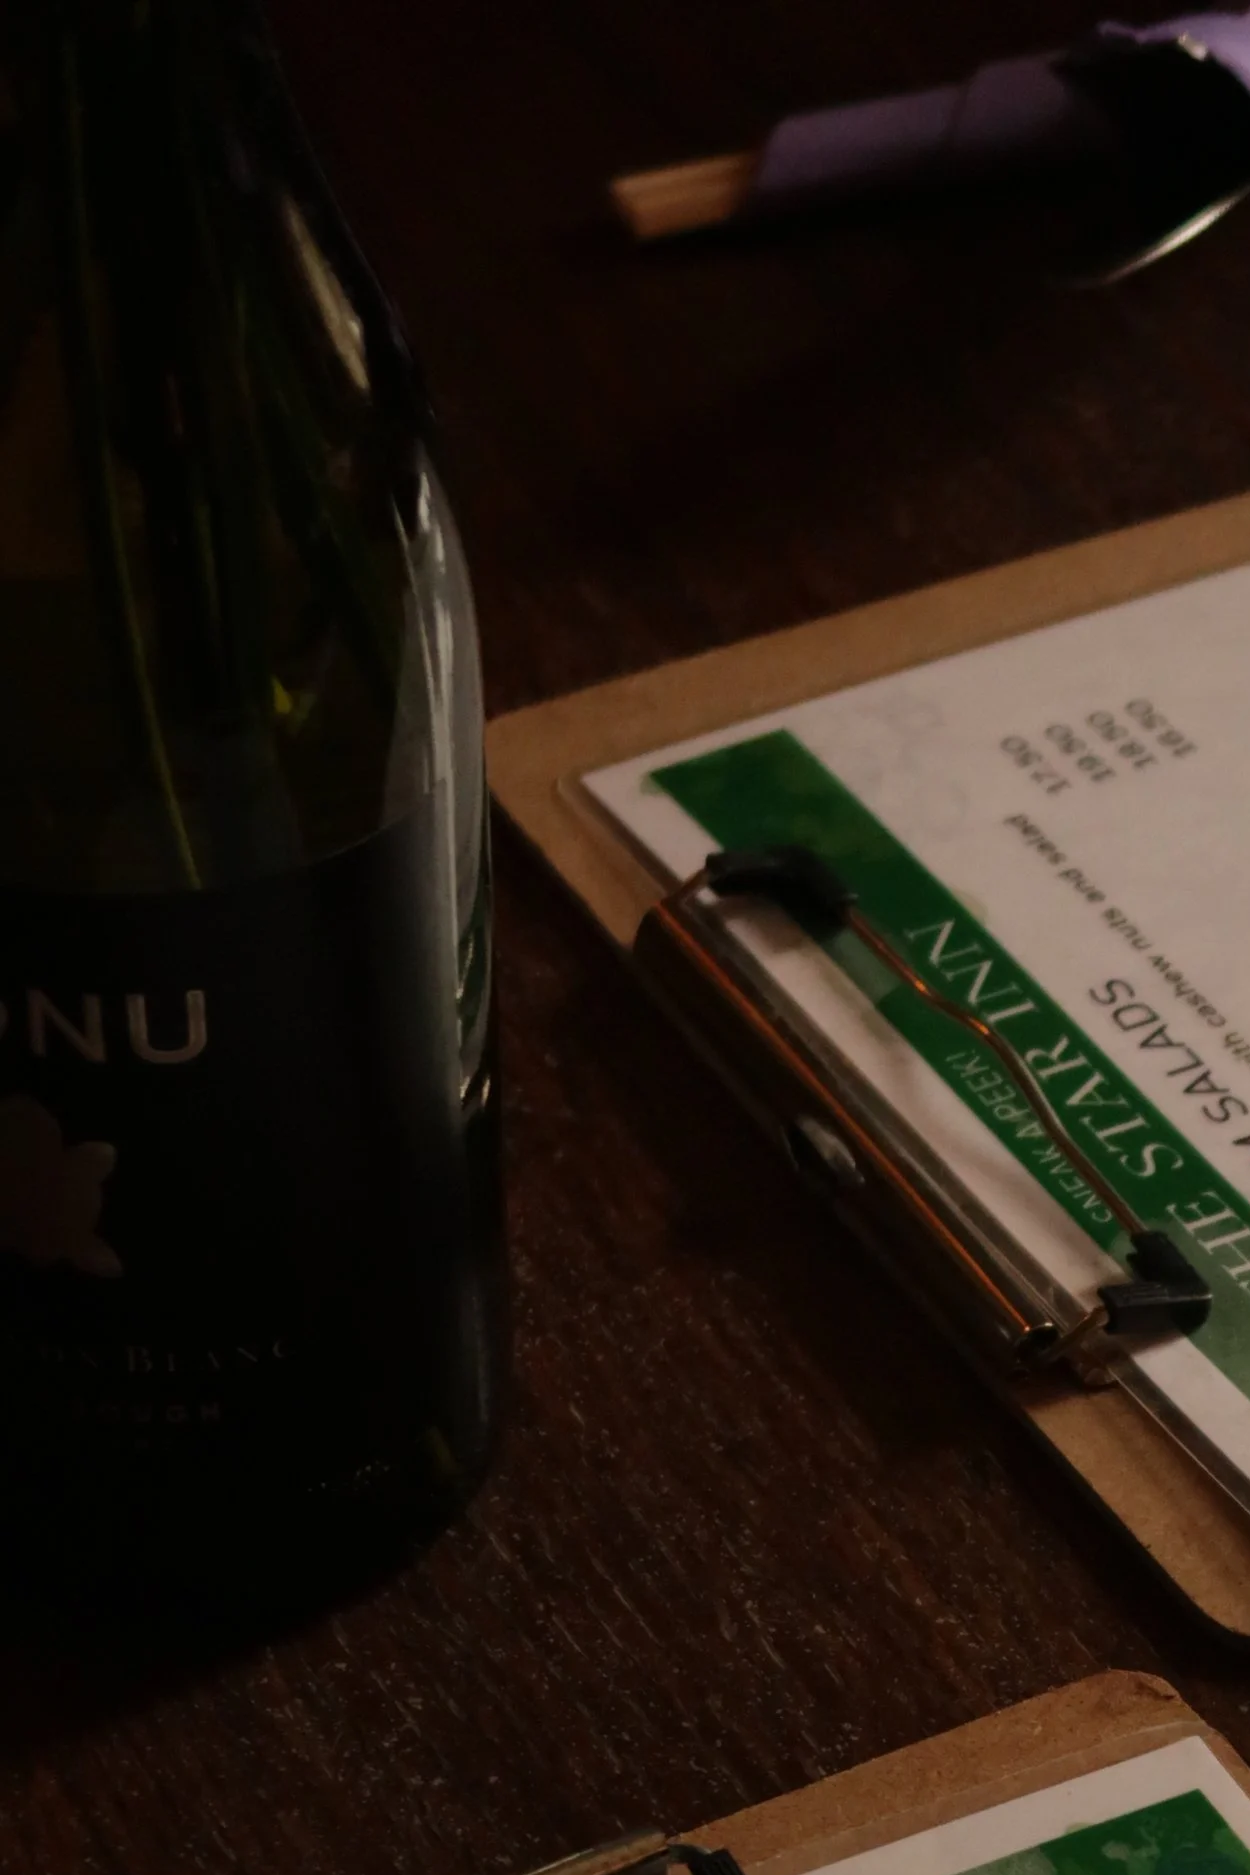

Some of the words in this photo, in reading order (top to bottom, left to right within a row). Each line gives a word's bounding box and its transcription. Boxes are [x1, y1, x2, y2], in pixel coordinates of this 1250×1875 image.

[1003, 814, 1067, 866] salad
[1056, 867, 1106, 904] and
[1101, 907, 1152, 952] nuts
[903, 917, 1038, 1026] INN
[1147, 955, 1228, 1029] cashew
[0, 988, 209, 1064] NU
[1088, 978, 1249, 1124] SALADS
[946, 1049, 1028, 1122] PEEK!
[1024, 1034, 1185, 1179] STAR
[1033, 1144, 1114, 1223] SNEAK
